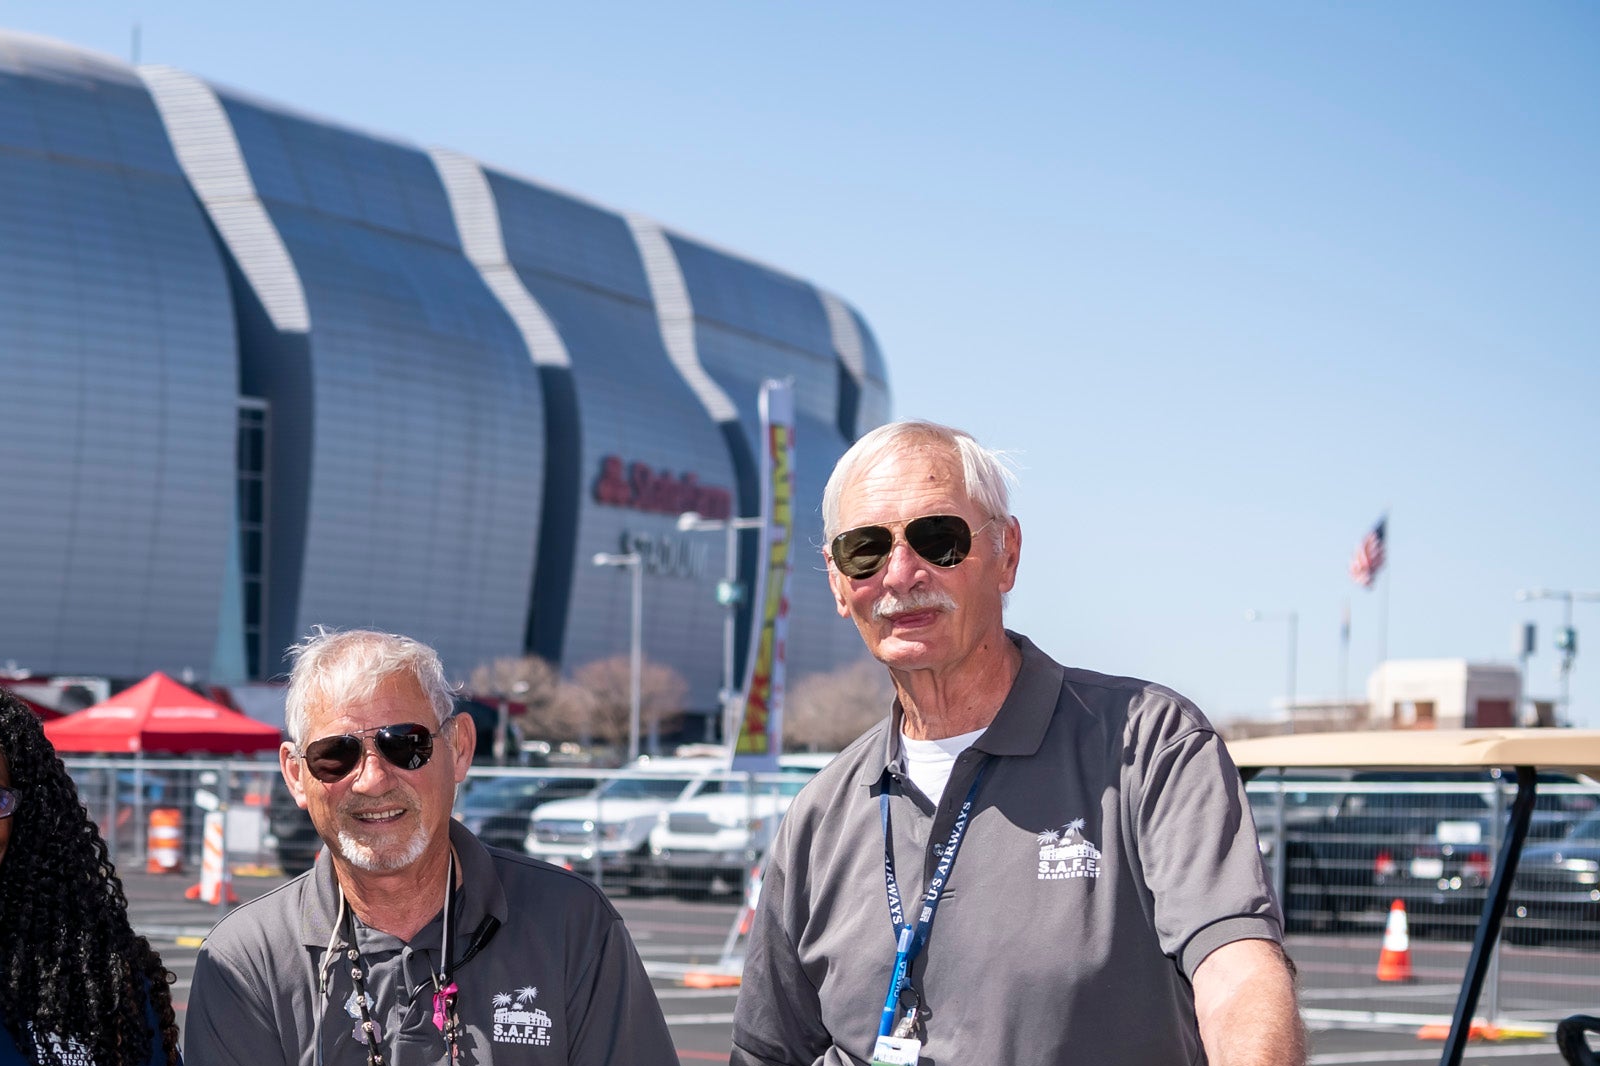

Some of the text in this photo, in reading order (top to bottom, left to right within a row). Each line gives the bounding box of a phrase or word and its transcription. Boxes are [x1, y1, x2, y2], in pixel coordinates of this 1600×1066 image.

[938, 801, 971, 876] AIRWAYS
[1038, 858, 1101, 874] S.A.F.E.
[1037, 870, 1101, 880] MANAGEMENT
[885, 853, 903, 925] AIRWAYS
[493, 1023, 551, 1040] S.A.F.E.
[493, 1035, 551, 1047] MANAGEMENT
